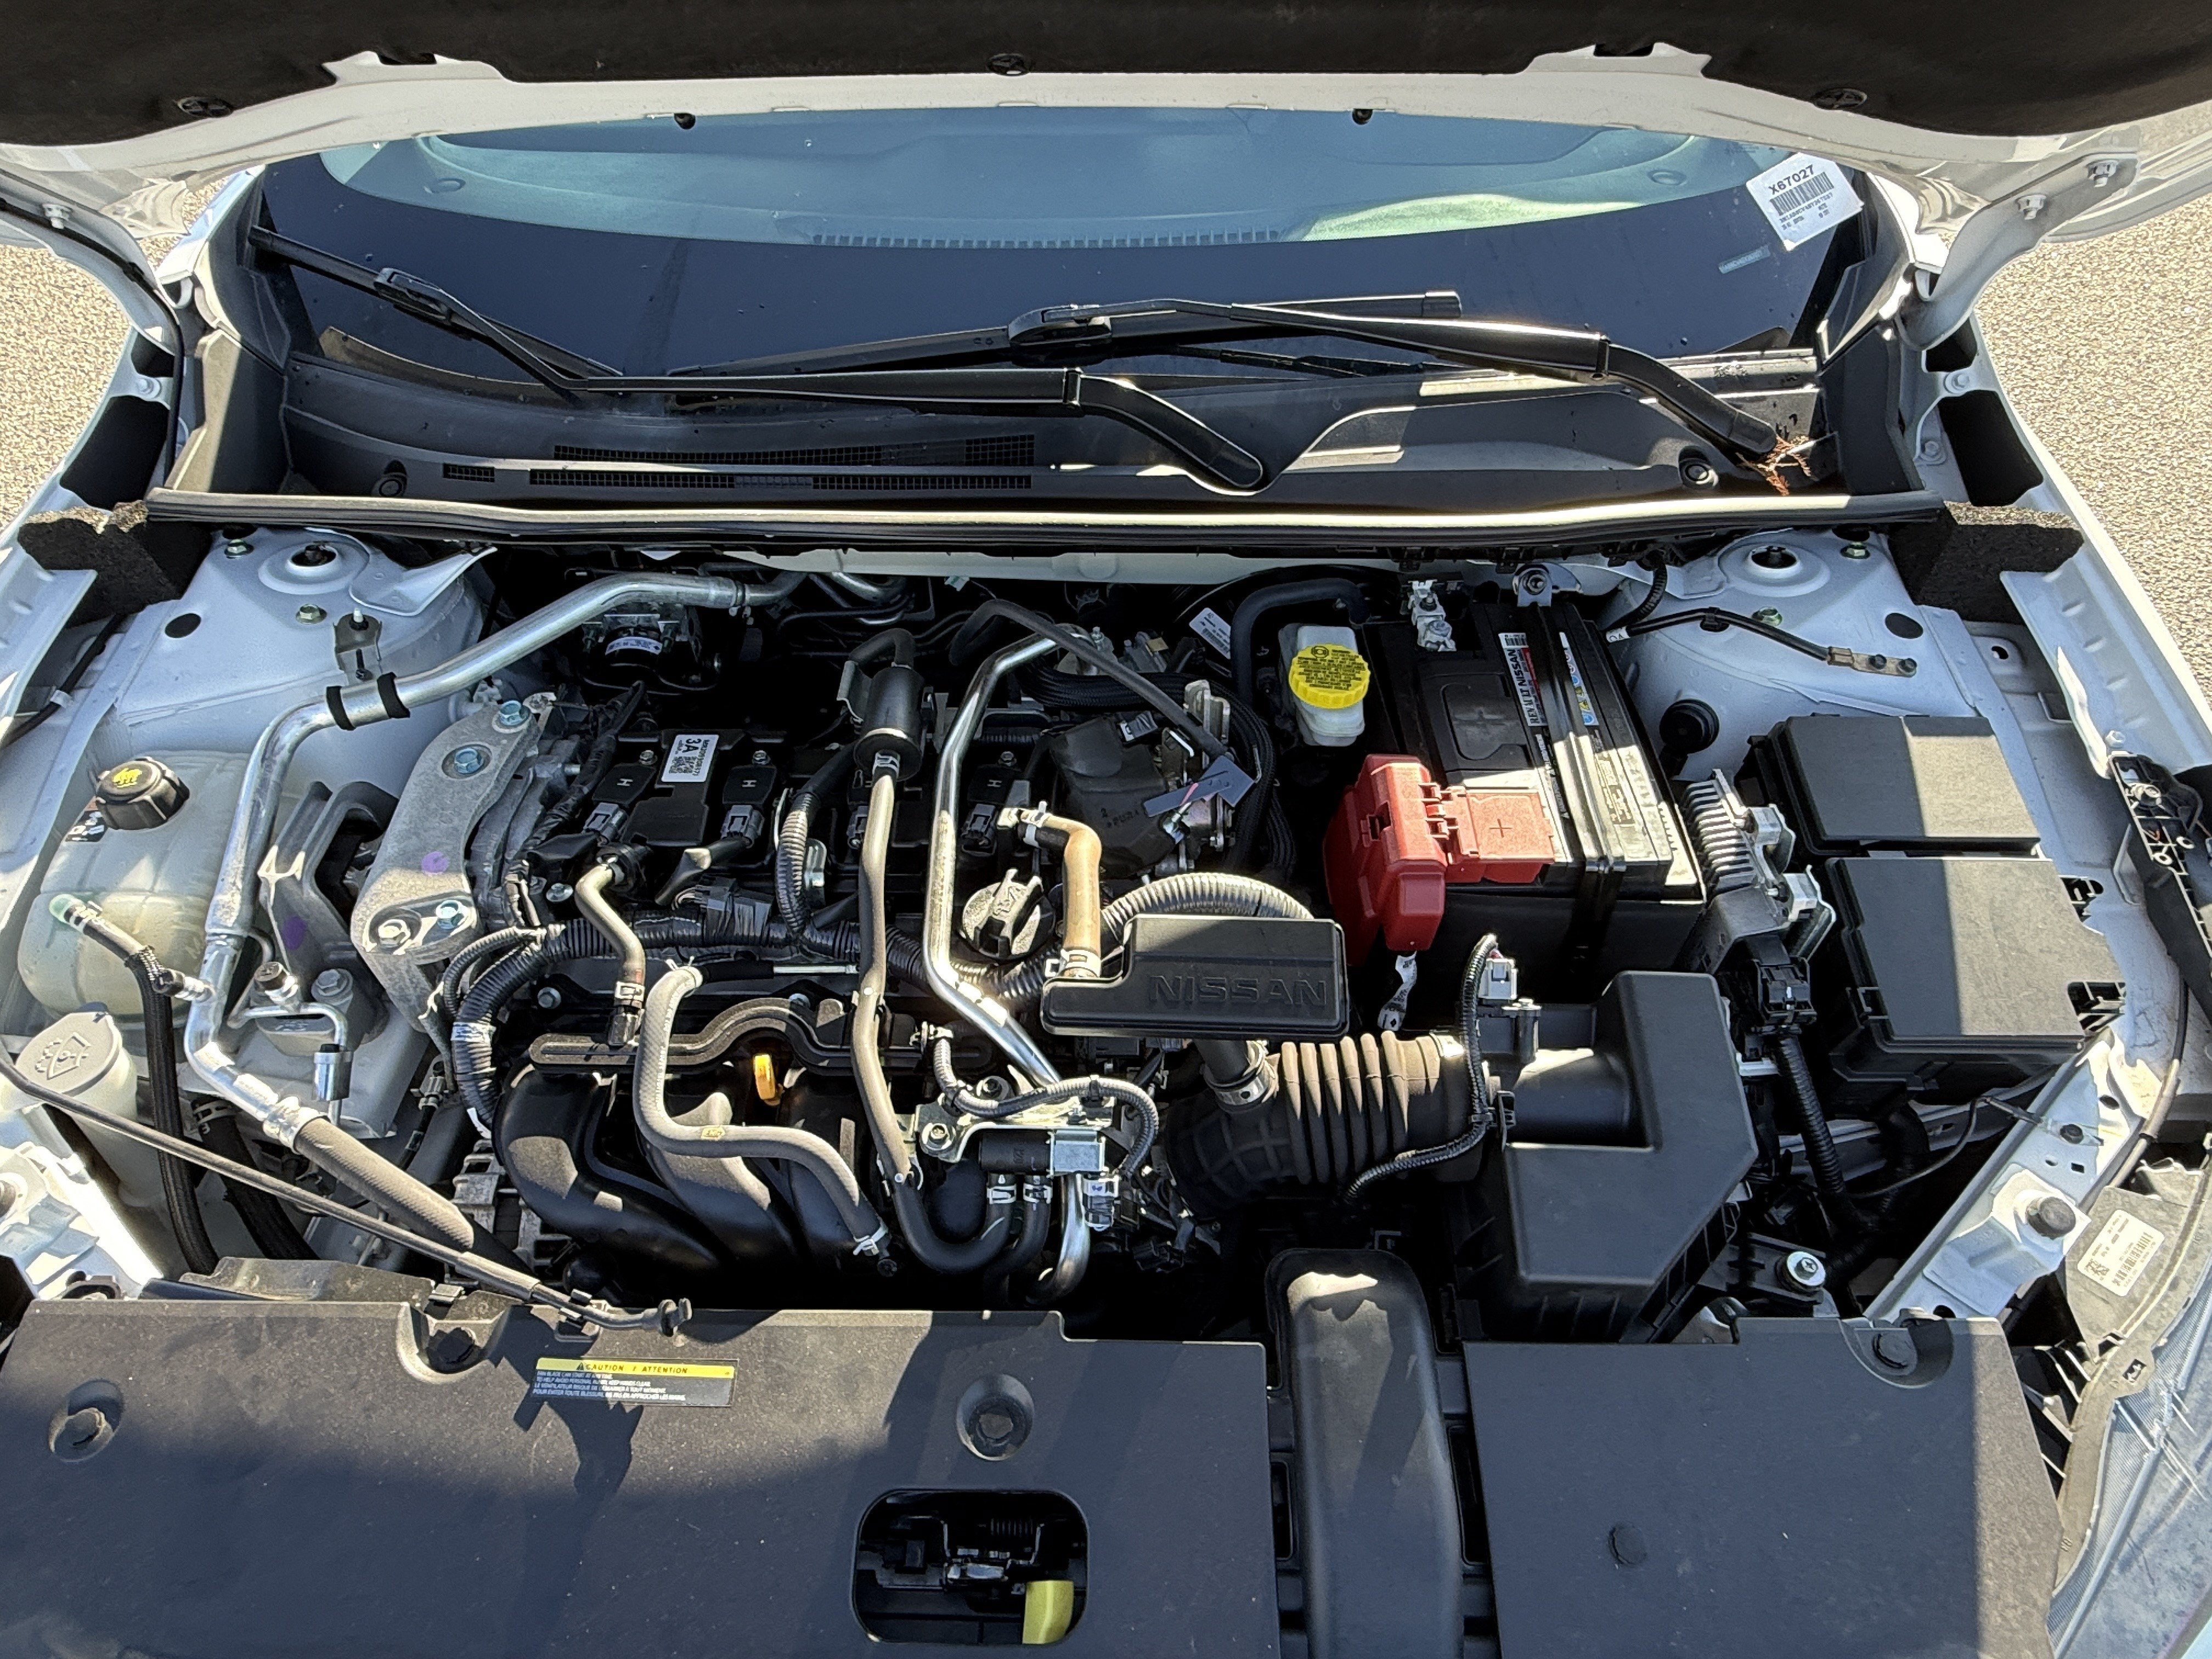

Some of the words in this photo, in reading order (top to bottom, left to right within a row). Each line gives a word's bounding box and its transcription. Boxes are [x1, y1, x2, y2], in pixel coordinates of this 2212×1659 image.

[1768, 165, 1814, 195] X67027
[1509, 649, 1525, 687] NISSAN
[682, 738, 702, 753] 3A
[1151, 975, 1327, 1008] NISSAN
